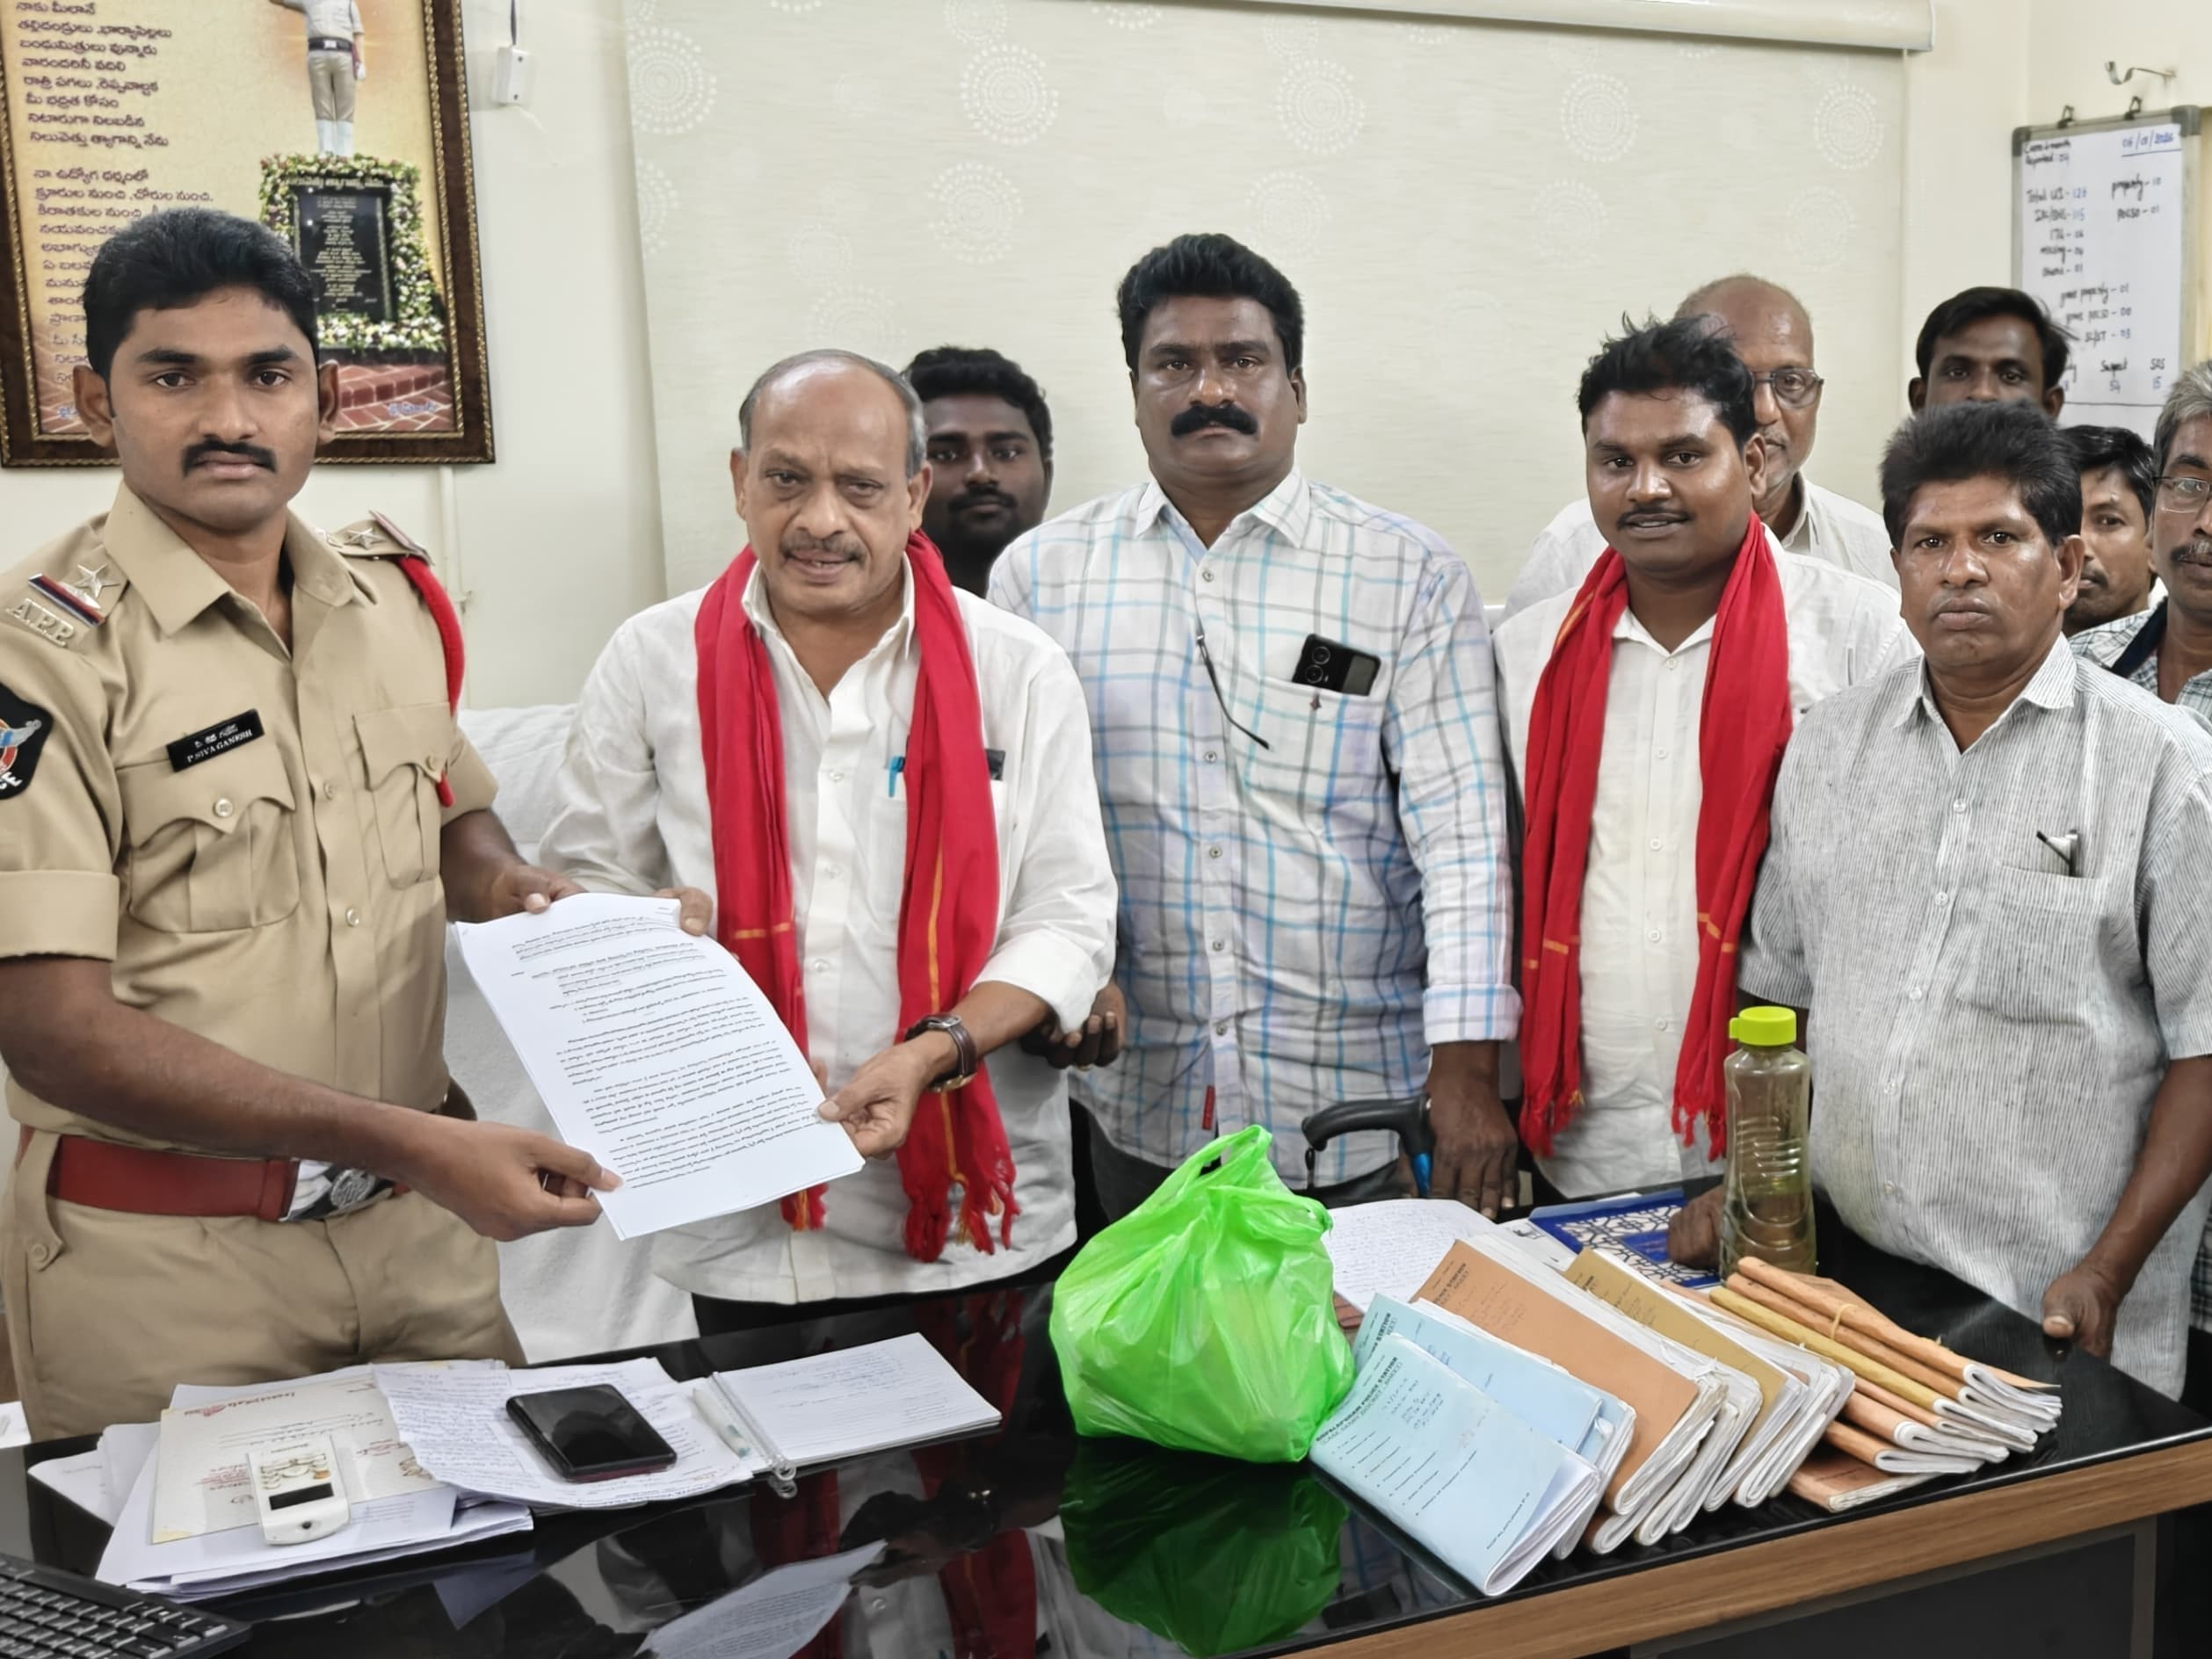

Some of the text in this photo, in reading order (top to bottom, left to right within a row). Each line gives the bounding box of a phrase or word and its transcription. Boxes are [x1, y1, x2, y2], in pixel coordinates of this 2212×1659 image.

[24, 76, 52, 89] రాత్రి
[55, 76, 92, 89] పగలు
[25, 91, 120, 109] మీ భద్రత కోసం
[28, 112, 90, 126] నిటారుగా
[143, 133, 170, 147] నేను
[33, 170, 52, 178] నా
